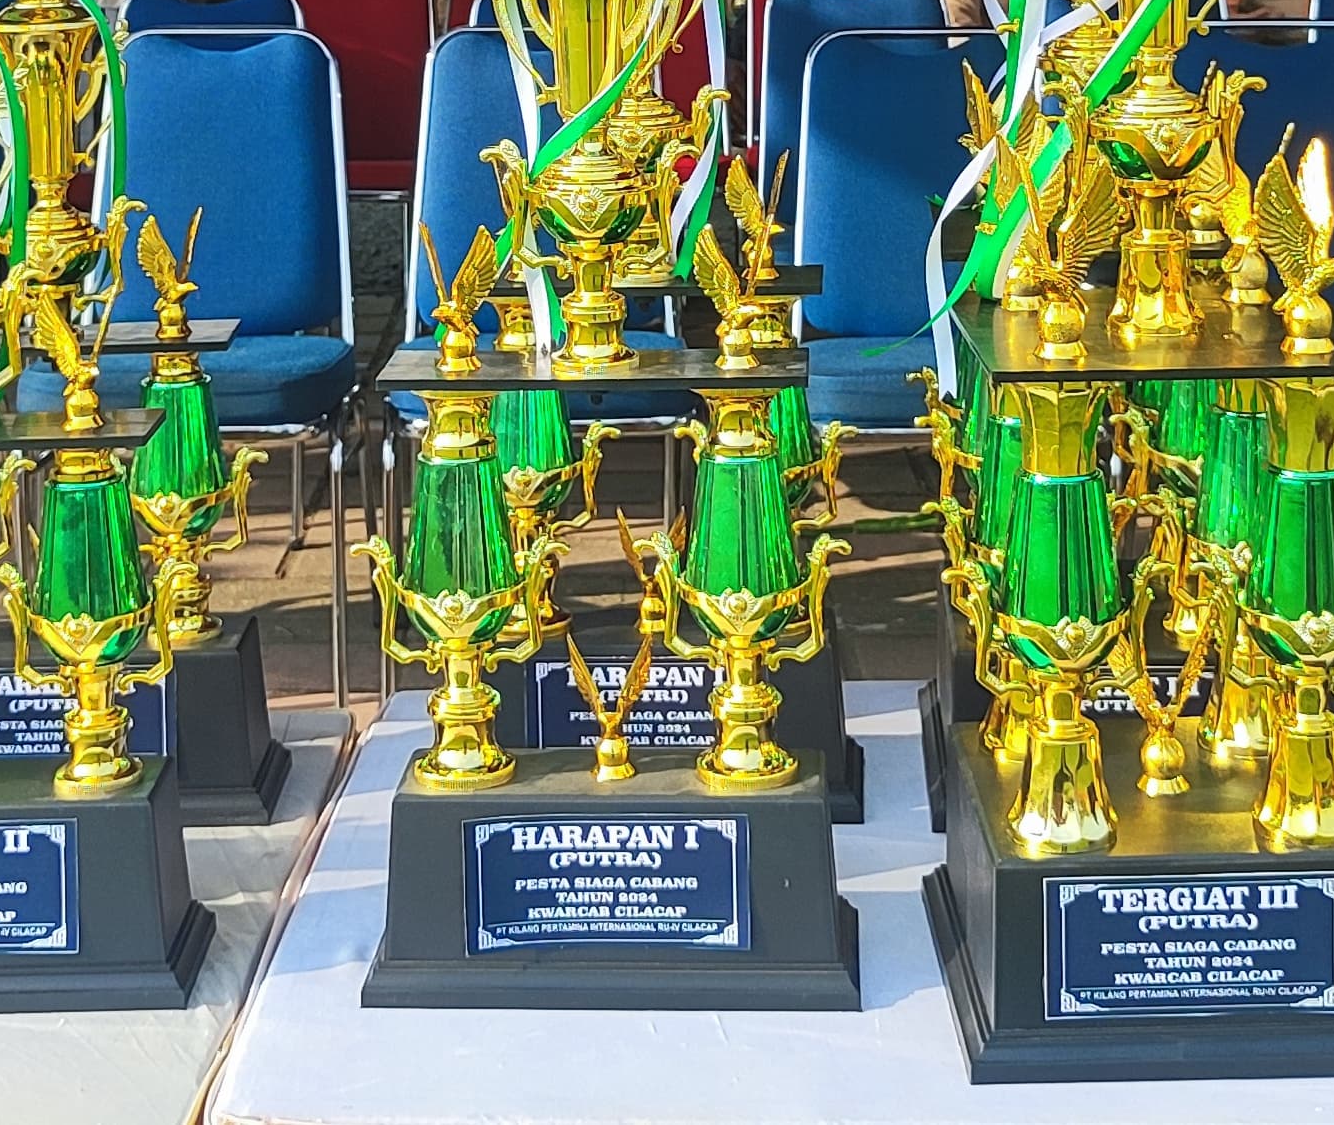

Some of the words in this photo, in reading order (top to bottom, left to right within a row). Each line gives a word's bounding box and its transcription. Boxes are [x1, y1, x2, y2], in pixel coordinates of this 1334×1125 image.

[599, 689, 688, 703] (PTRI)
[629, 711, 663, 720] IAGA
[667, 711, 715, 720] CABAN
[31, 720, 64, 729] SIAG
[622, 724, 656, 733] HUN
[658, 724, 690, 733] 2024
[15, 732, 63, 742] TAHUN
[654, 736, 715, 746] CILACAP
[2, 829, 30, 854] II
[512, 826, 674, 852] HARAPAN
[684, 825, 699, 850] I
[549, 851, 662, 869] (PUTRA)
[515, 879, 570, 891] PESTA
[574, 877, 627, 889] SIAGA
[630, 877, 698, 890] CABANG
[555, 892, 614, 903] TAHUN
[619, 892, 658, 903] 2024
[1098, 886, 1250, 913] TERGIAT
[1258, 885, 1298, 909] III
[528, 907, 610, 919] KWARCAB
[614, 906, 687, 918] CILACAP
[496, 926, 507, 935] PT
[509, 925, 539, 935] KILANG
[541, 923, 588, 933] PERTAMINA
[590, 923, 656, 932] INTERNASIONAL
[682, 922, 718, 932] CILACAP
[1139, 913, 1258, 933] (PUTRA)
[12, 927, 47, 936] CILACAP
[1101, 943, 1160, 955] PESTA
[1165, 942, 1220, 953] SIAGA
[1224, 938, 1296, 951] CABANG
[1144, 957, 1206, 969] TAHUN
[1211, 956, 1253, 967] 2024
[1115, 972, 1203, 985] KWARCAB
[1207, 970, 1284, 982] CILACAP
[1081, 992, 1092, 1000] PT
[1094, 990, 1126, 1000] KILANG
[1128, 988, 1179, 999] PERTAMINA
[1181, 987, 1250, 998] INTERNASIONAL
[1278, 985, 1317, 996] CILACAP
